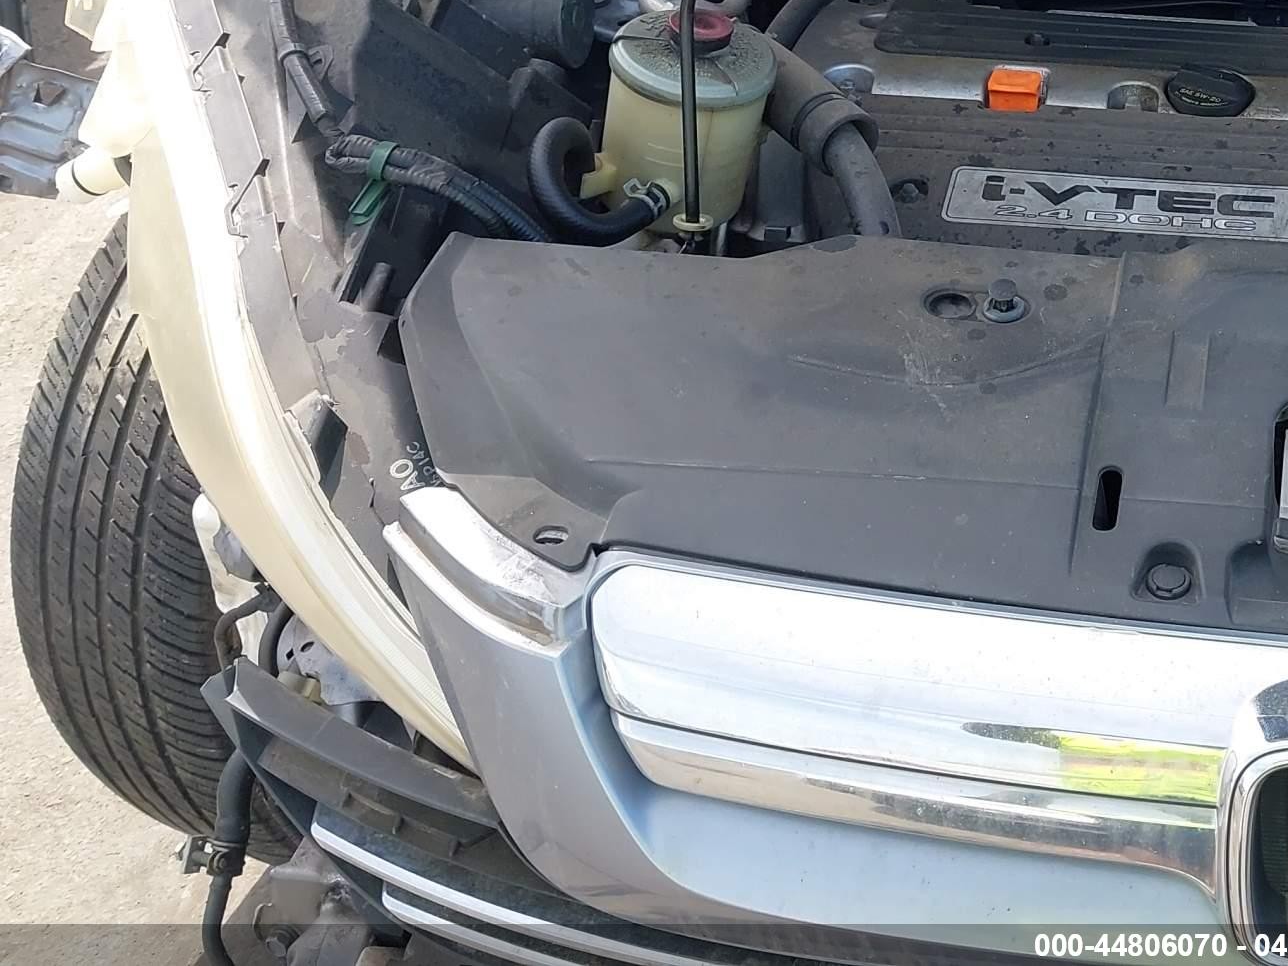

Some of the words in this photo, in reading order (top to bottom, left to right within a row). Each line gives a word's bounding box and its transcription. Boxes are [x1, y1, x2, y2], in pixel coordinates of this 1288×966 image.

[981, 175, 1275, 218] i-VTEC
[994, 204, 1073, 221] 2.4
[1084, 210, 1257, 231] DOHC
